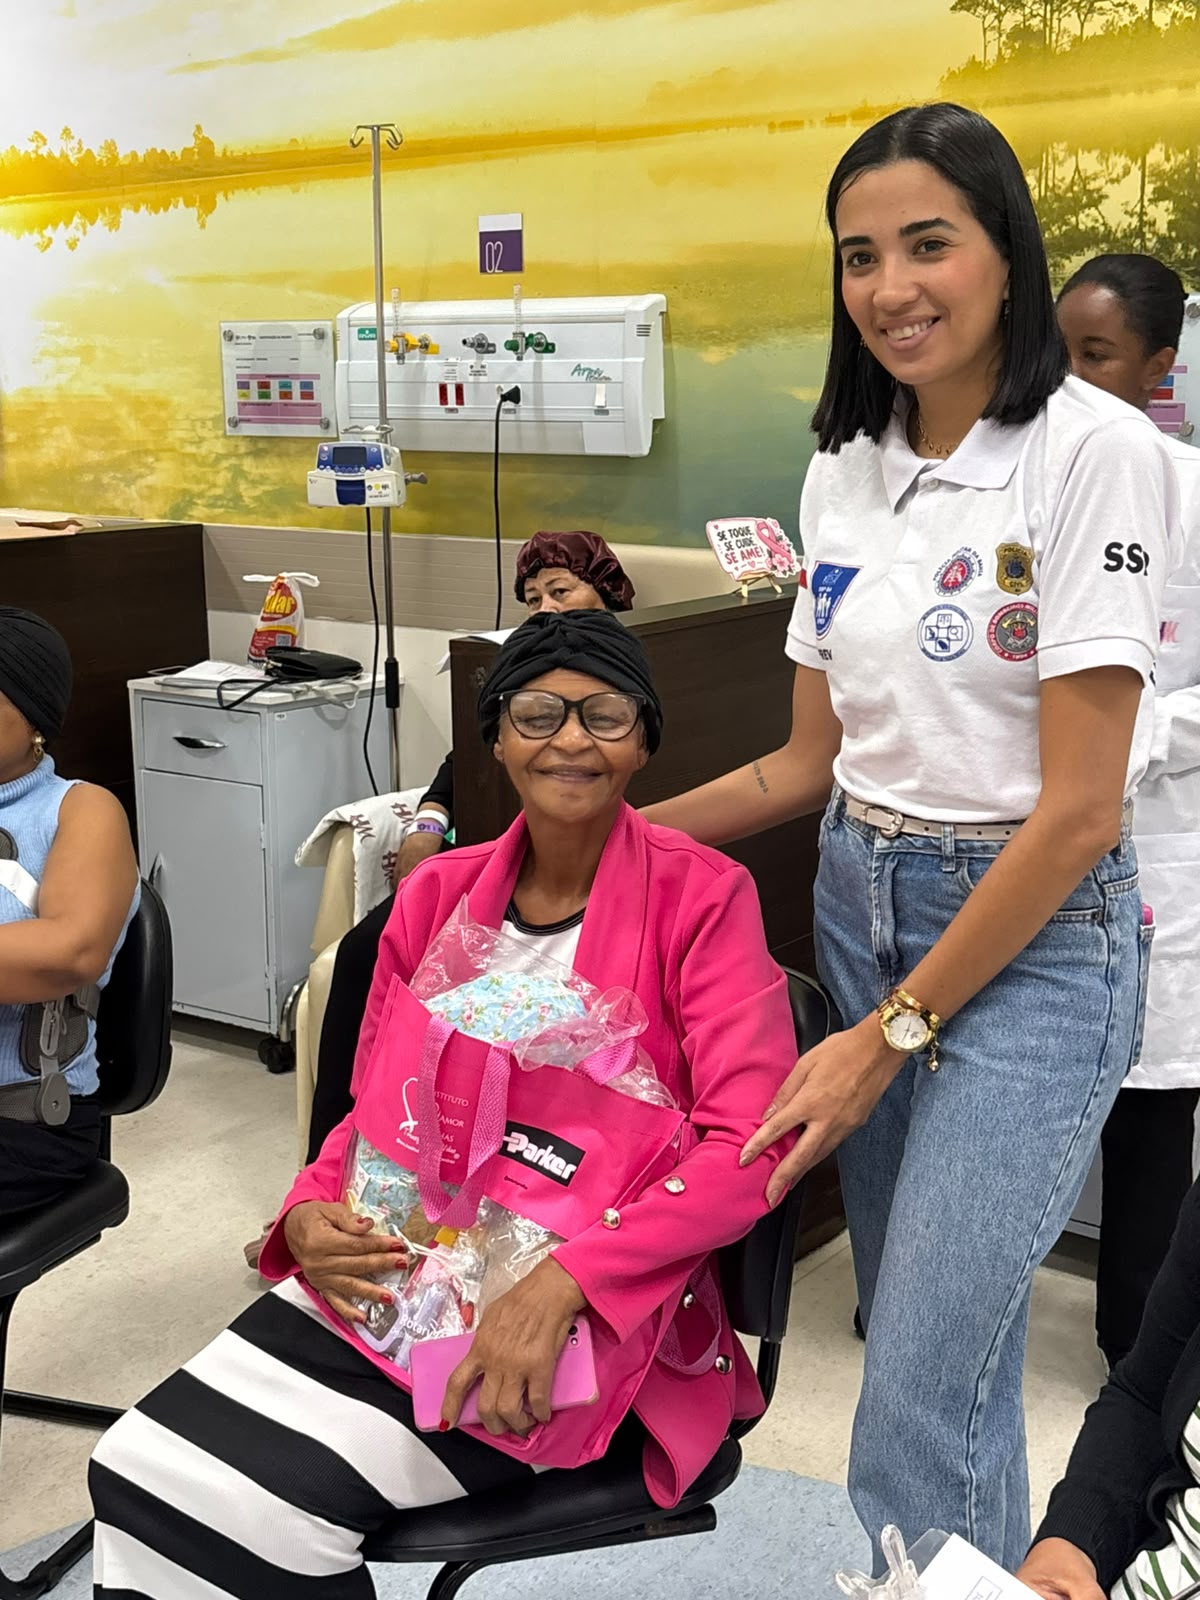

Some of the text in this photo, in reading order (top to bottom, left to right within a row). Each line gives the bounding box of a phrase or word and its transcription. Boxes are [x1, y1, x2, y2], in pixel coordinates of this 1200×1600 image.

[486, 241, 503, 273] 02
[717, 530, 727, 541] SE
[724, 541, 734, 551] SE
[725, 546, 766, 565] SE AME!
[818, 649, 833, 661] REV
[435, 1090, 469, 1107] STITUTO
[503, 1131, 577, 1180] Parker
